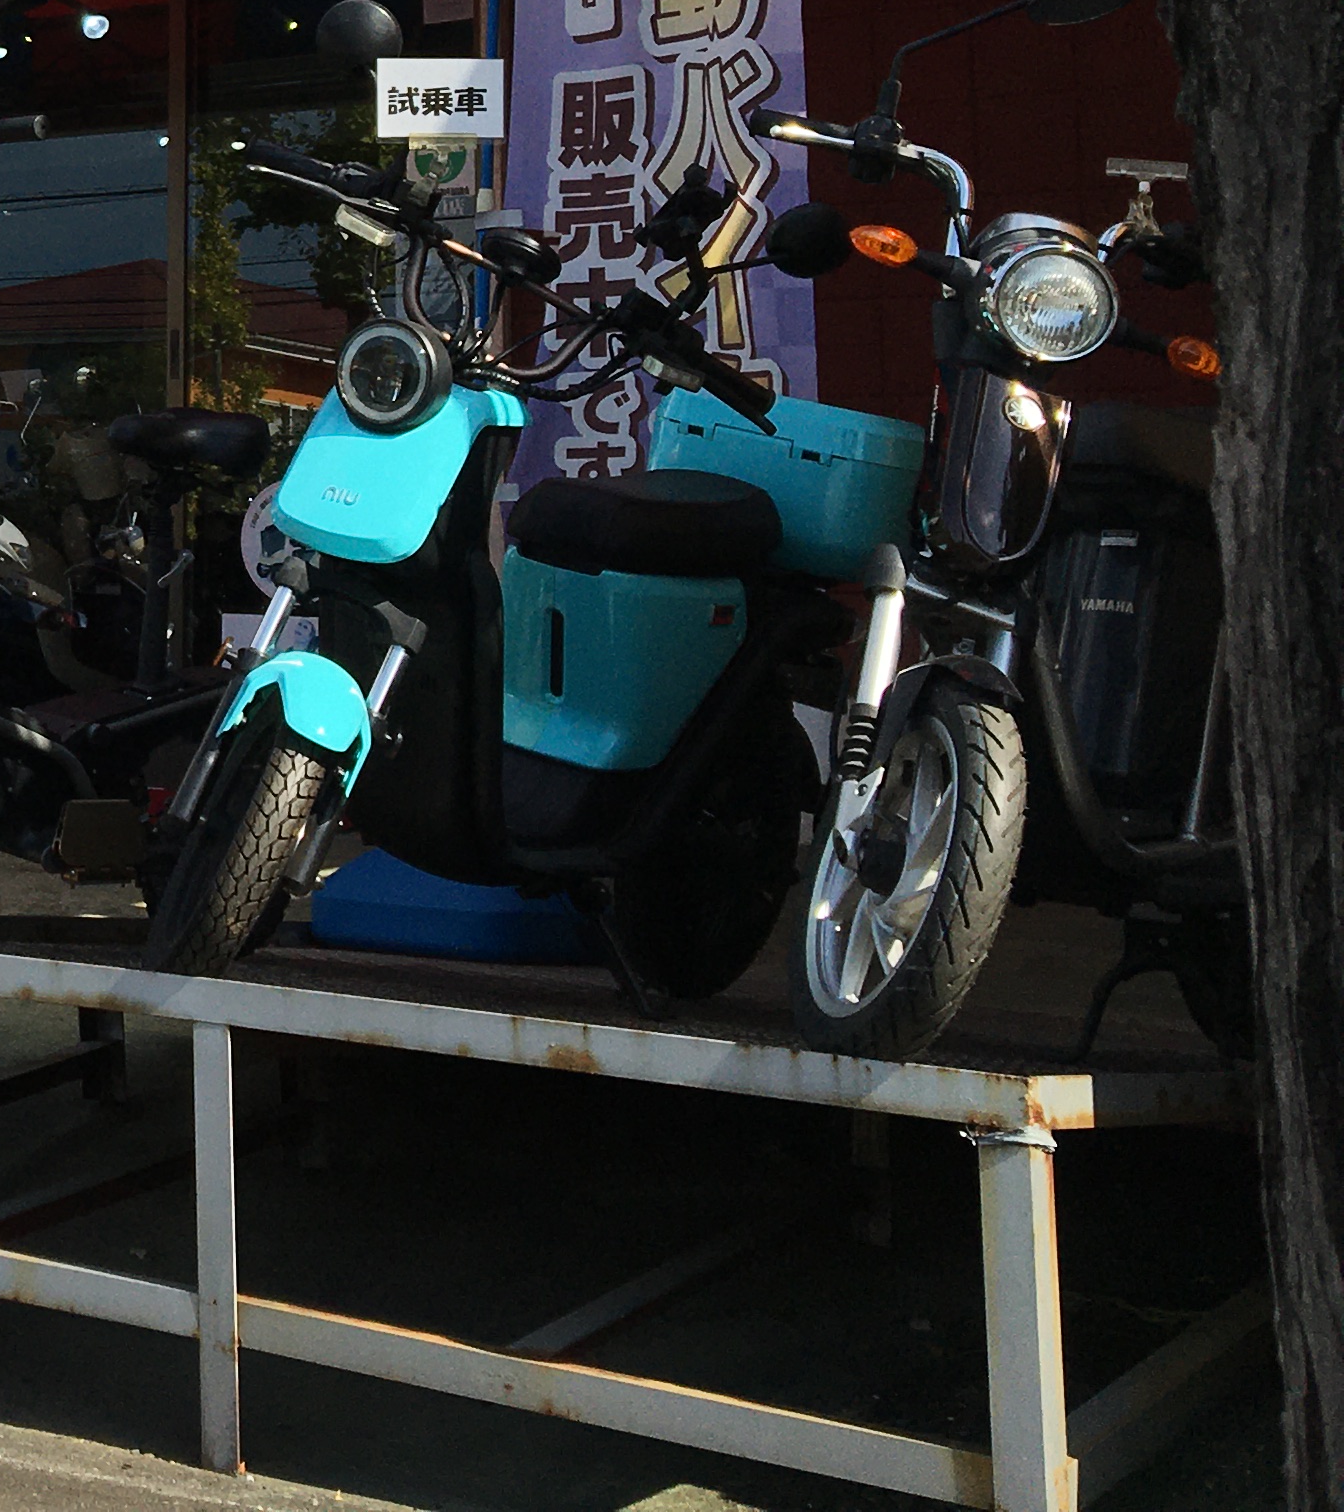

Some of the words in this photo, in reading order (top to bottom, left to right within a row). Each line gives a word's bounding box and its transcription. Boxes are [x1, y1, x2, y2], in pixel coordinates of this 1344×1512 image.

[387, 86, 488, 118] 試乗車
[1080, 598, 1135, 614] YAMAHA
